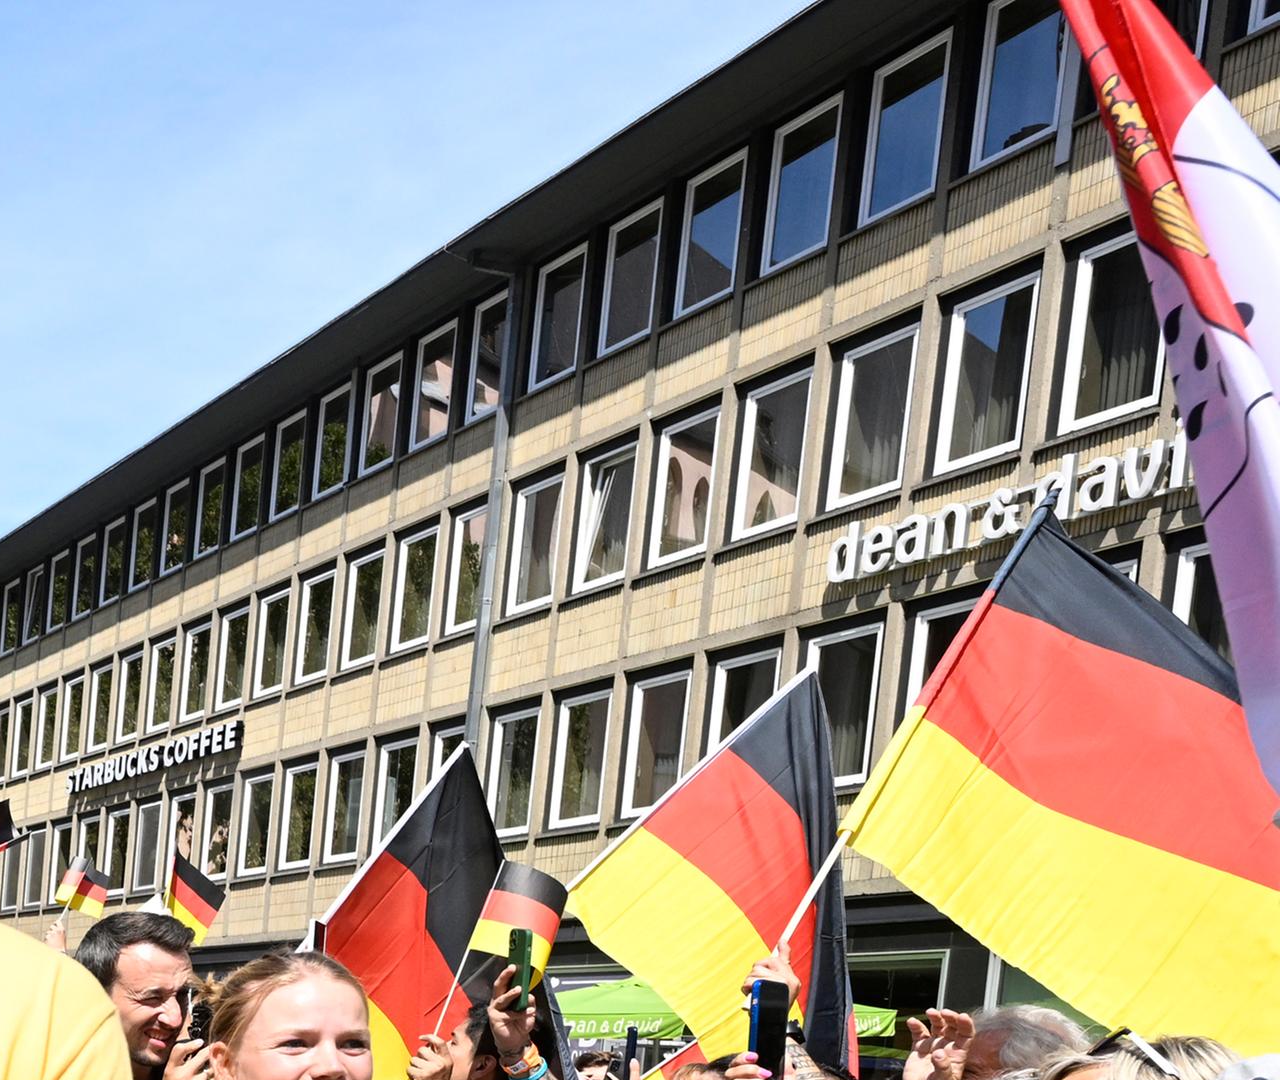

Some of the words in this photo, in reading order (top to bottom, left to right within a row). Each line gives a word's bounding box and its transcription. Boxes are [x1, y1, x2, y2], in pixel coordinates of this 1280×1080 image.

[827, 503, 972, 584] dean
[982, 487, 1024, 540] &
[65, 745, 160, 794] STARBUCKS
[162, 720, 239, 768] COFFEE
